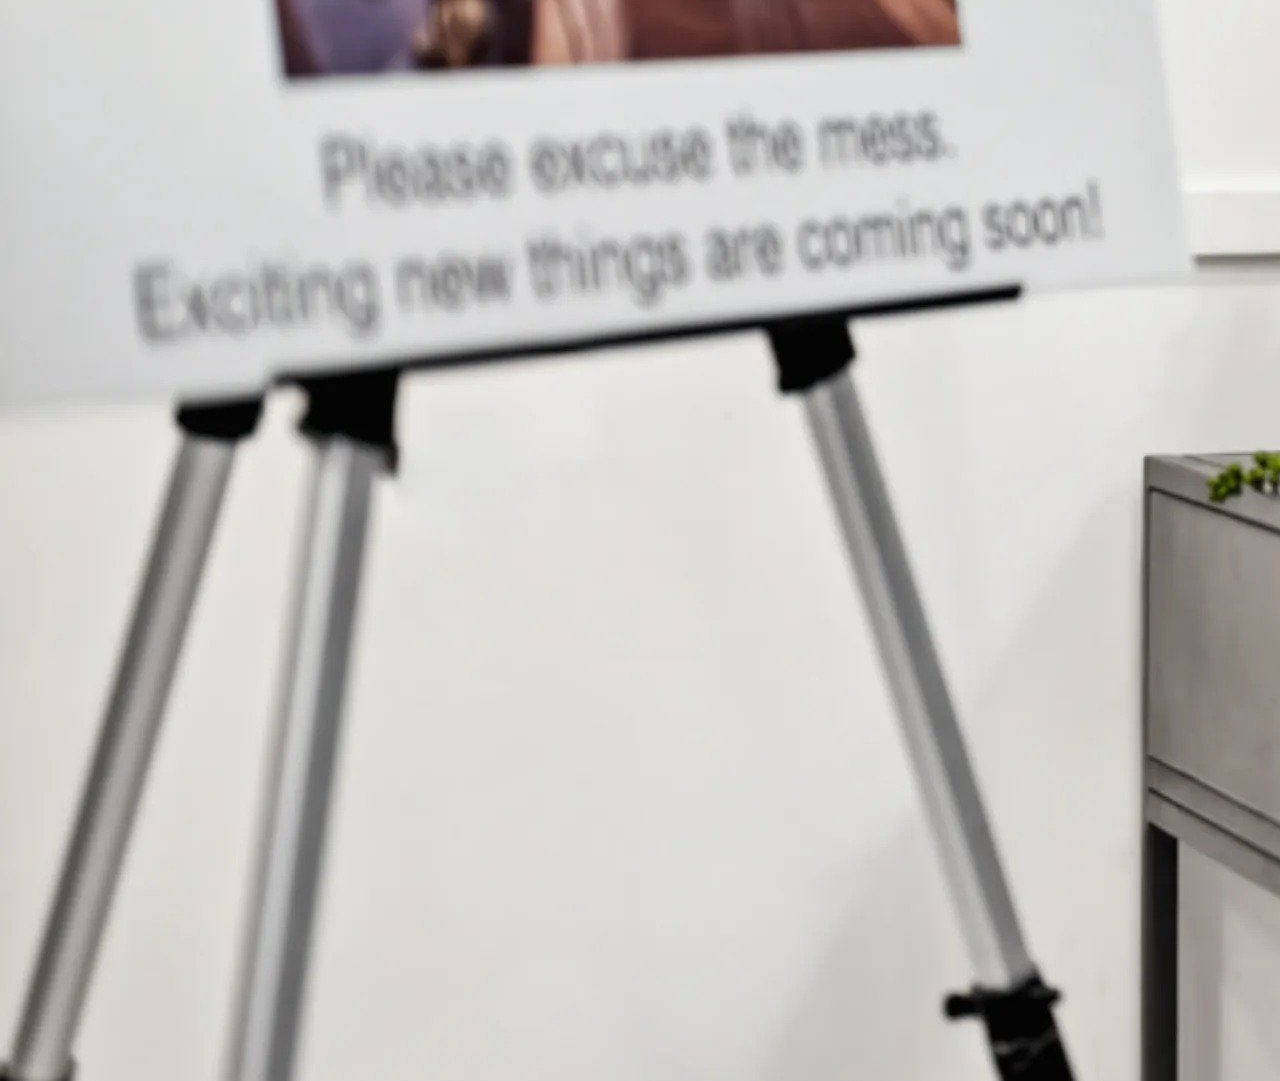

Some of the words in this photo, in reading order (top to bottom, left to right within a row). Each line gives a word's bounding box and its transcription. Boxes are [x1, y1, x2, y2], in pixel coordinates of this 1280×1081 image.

[319, 125, 510, 212] Please
[531, 134, 711, 195] excuse
[726, 108, 800, 178] the
[819, 106, 956, 168] mess.
[131, 255, 381, 345] Exciting
[395, 250, 512, 308] new
[528, 228, 690, 306] things
[707, 222, 785, 278] are
[800, 204, 970, 272] coming
[983, 182, 1102, 250] soon!
